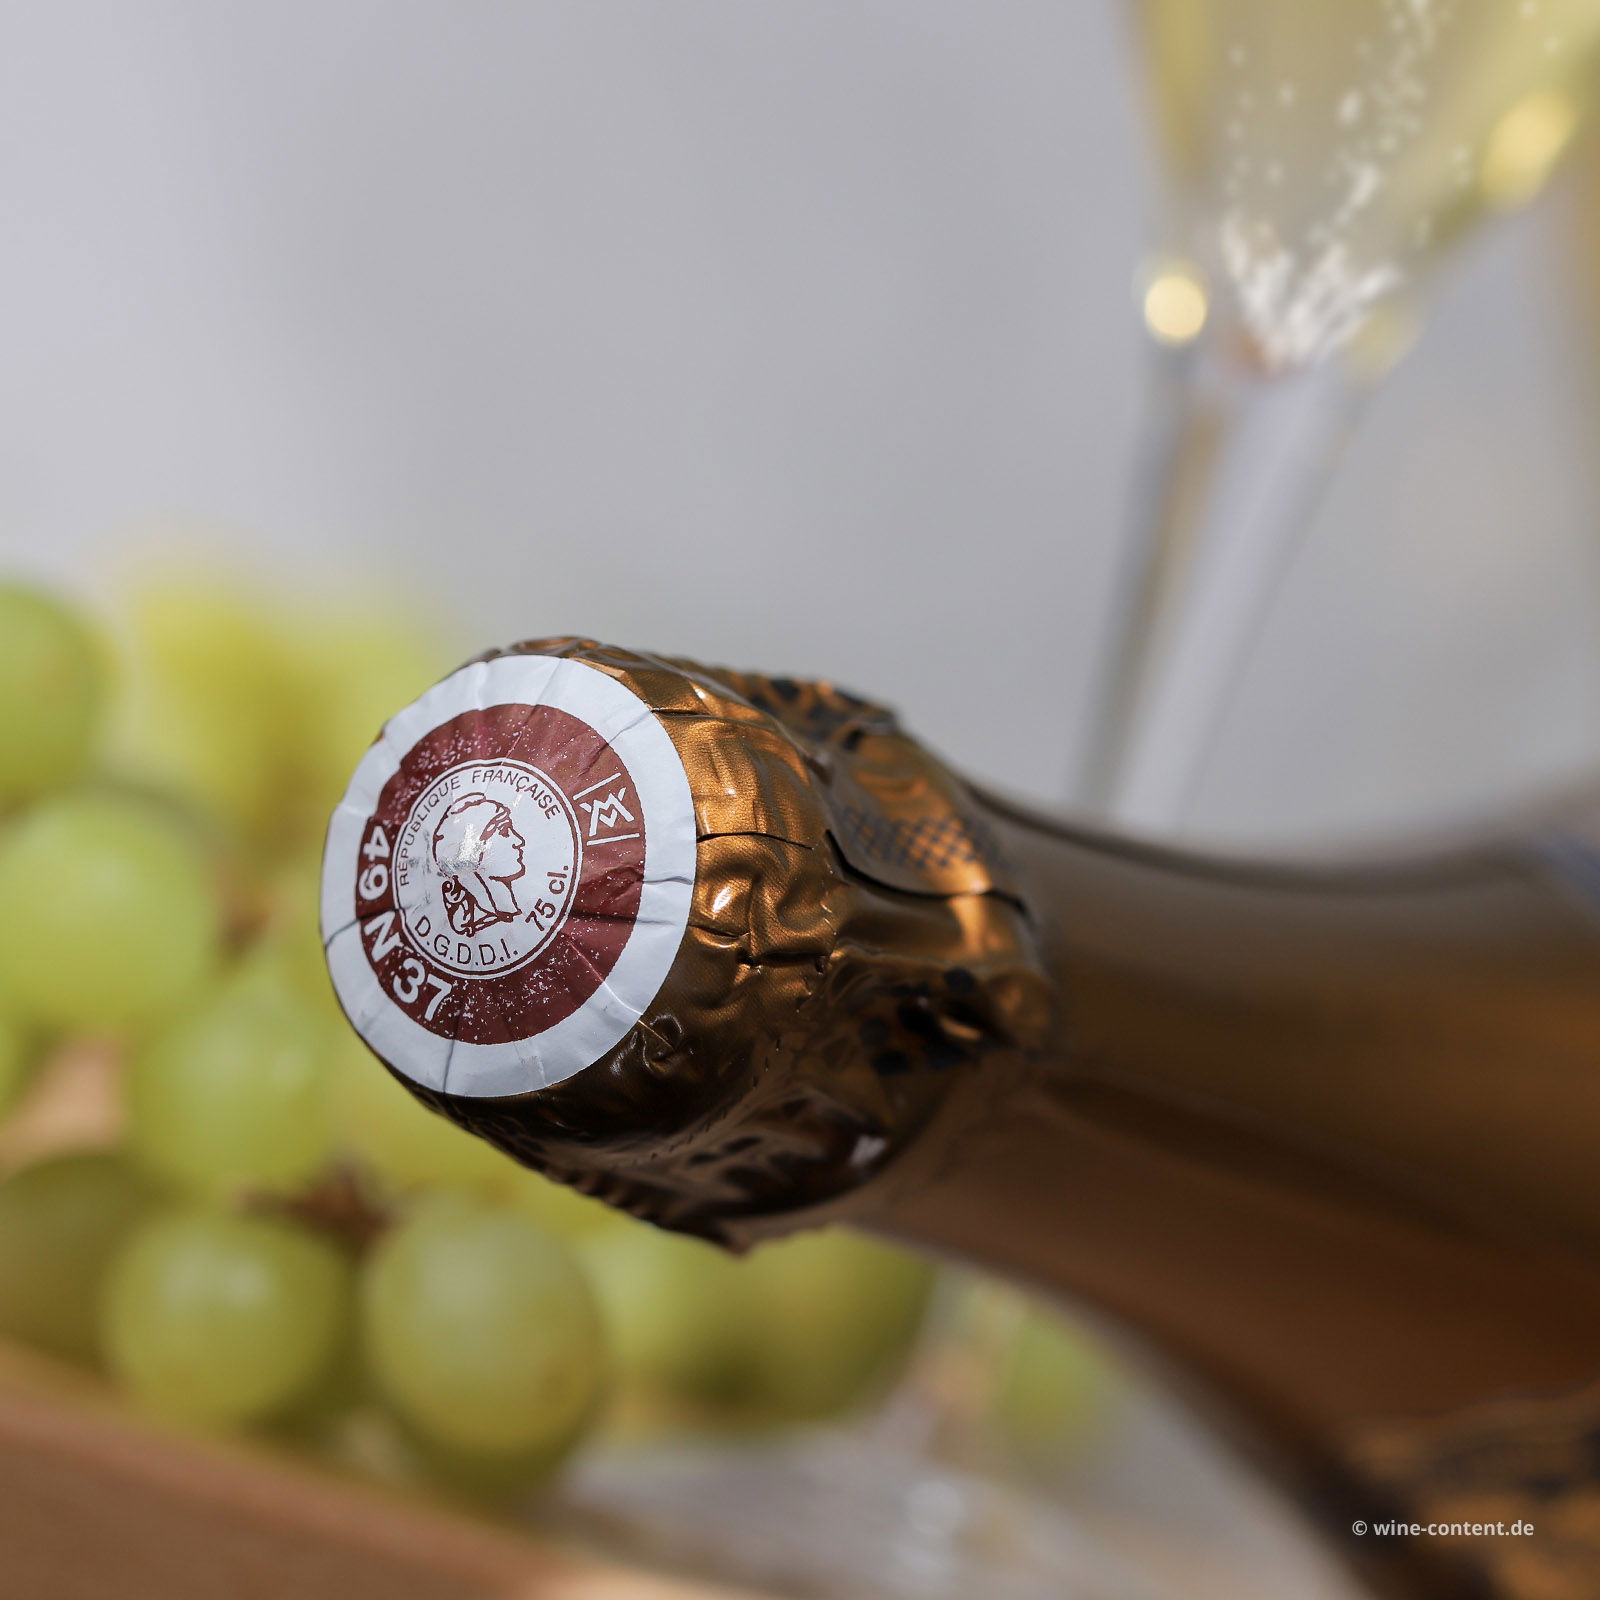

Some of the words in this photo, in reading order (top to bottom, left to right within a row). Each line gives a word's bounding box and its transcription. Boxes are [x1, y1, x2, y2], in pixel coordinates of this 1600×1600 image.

[471, 769, 561, 820] FRANÇAISE
[359, 826, 390, 900] 49
[393, 957, 453, 1022] 37
[414, 915, 518, 966] D.G.D.D.I.
[525, 898, 557, 932] 75
